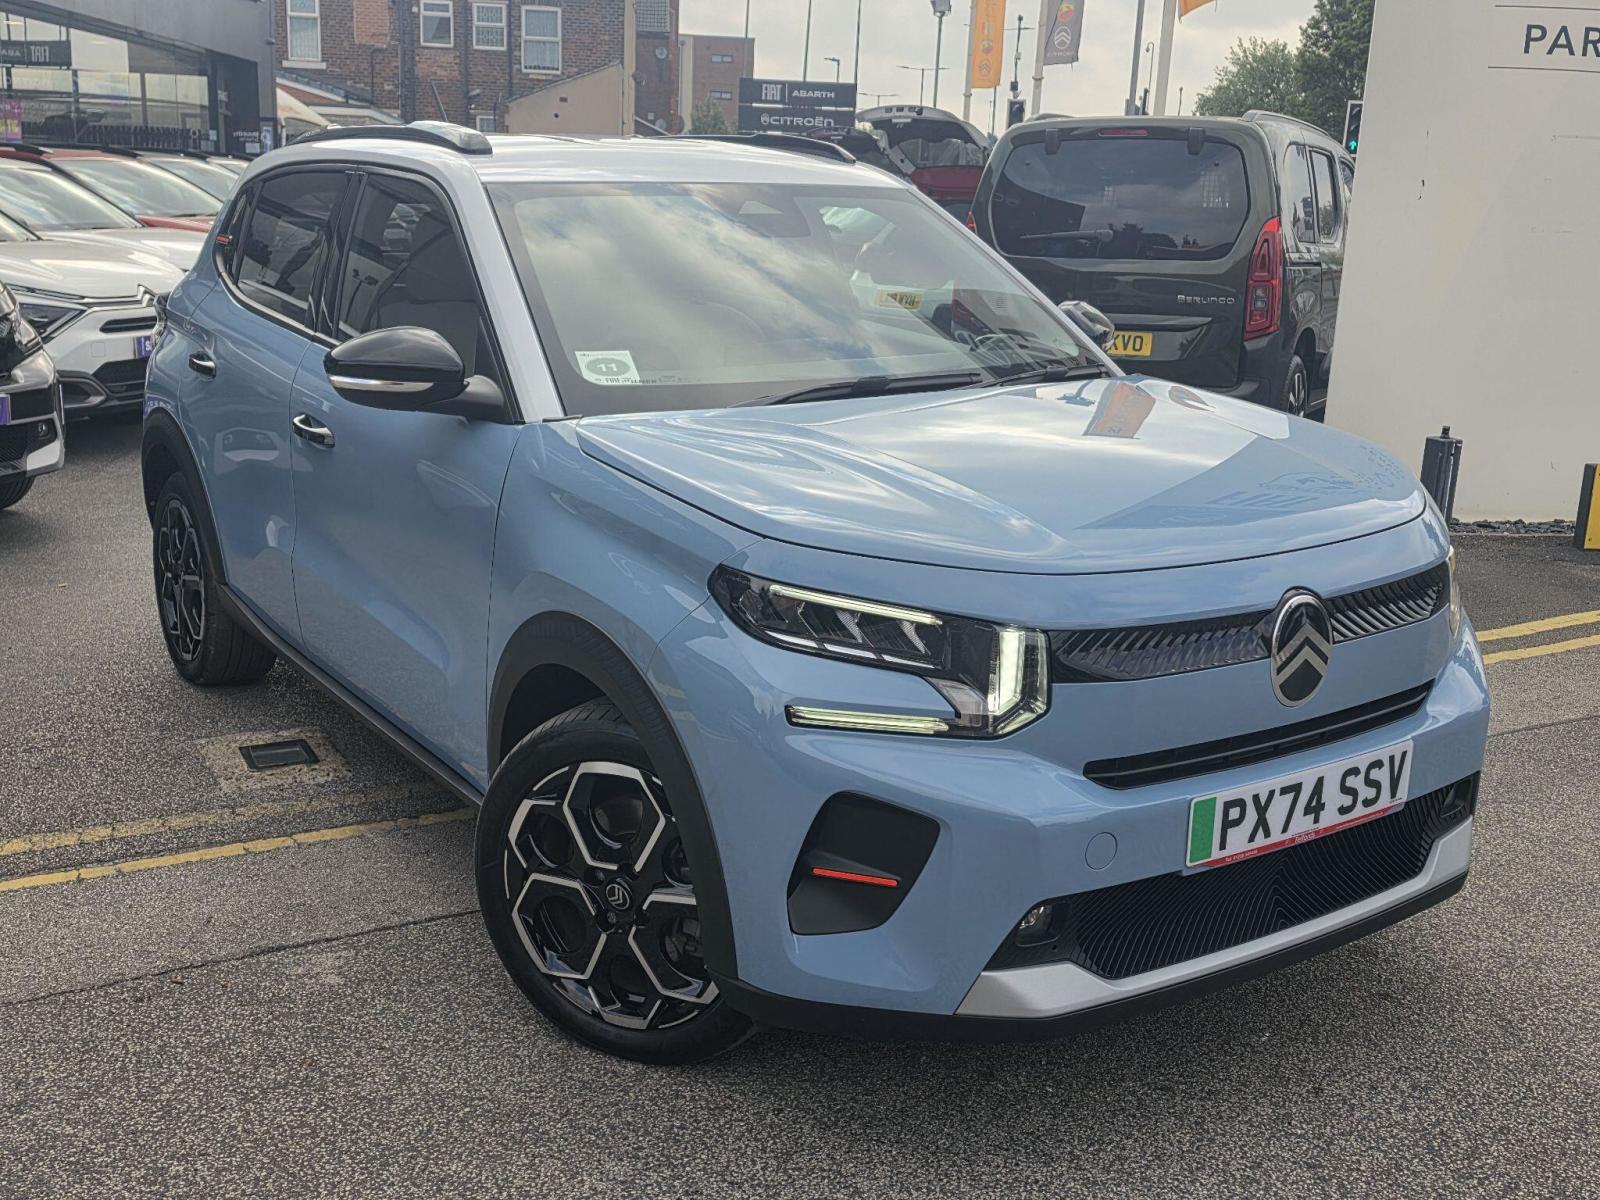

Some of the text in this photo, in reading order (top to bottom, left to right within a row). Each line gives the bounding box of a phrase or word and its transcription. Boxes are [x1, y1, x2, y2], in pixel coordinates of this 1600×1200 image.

[1523, 24, 1600, 58] PAR
[761, 83, 836, 101] FIAT ABARTH
[1219, 750, 1408, 852] PX74 SSV
